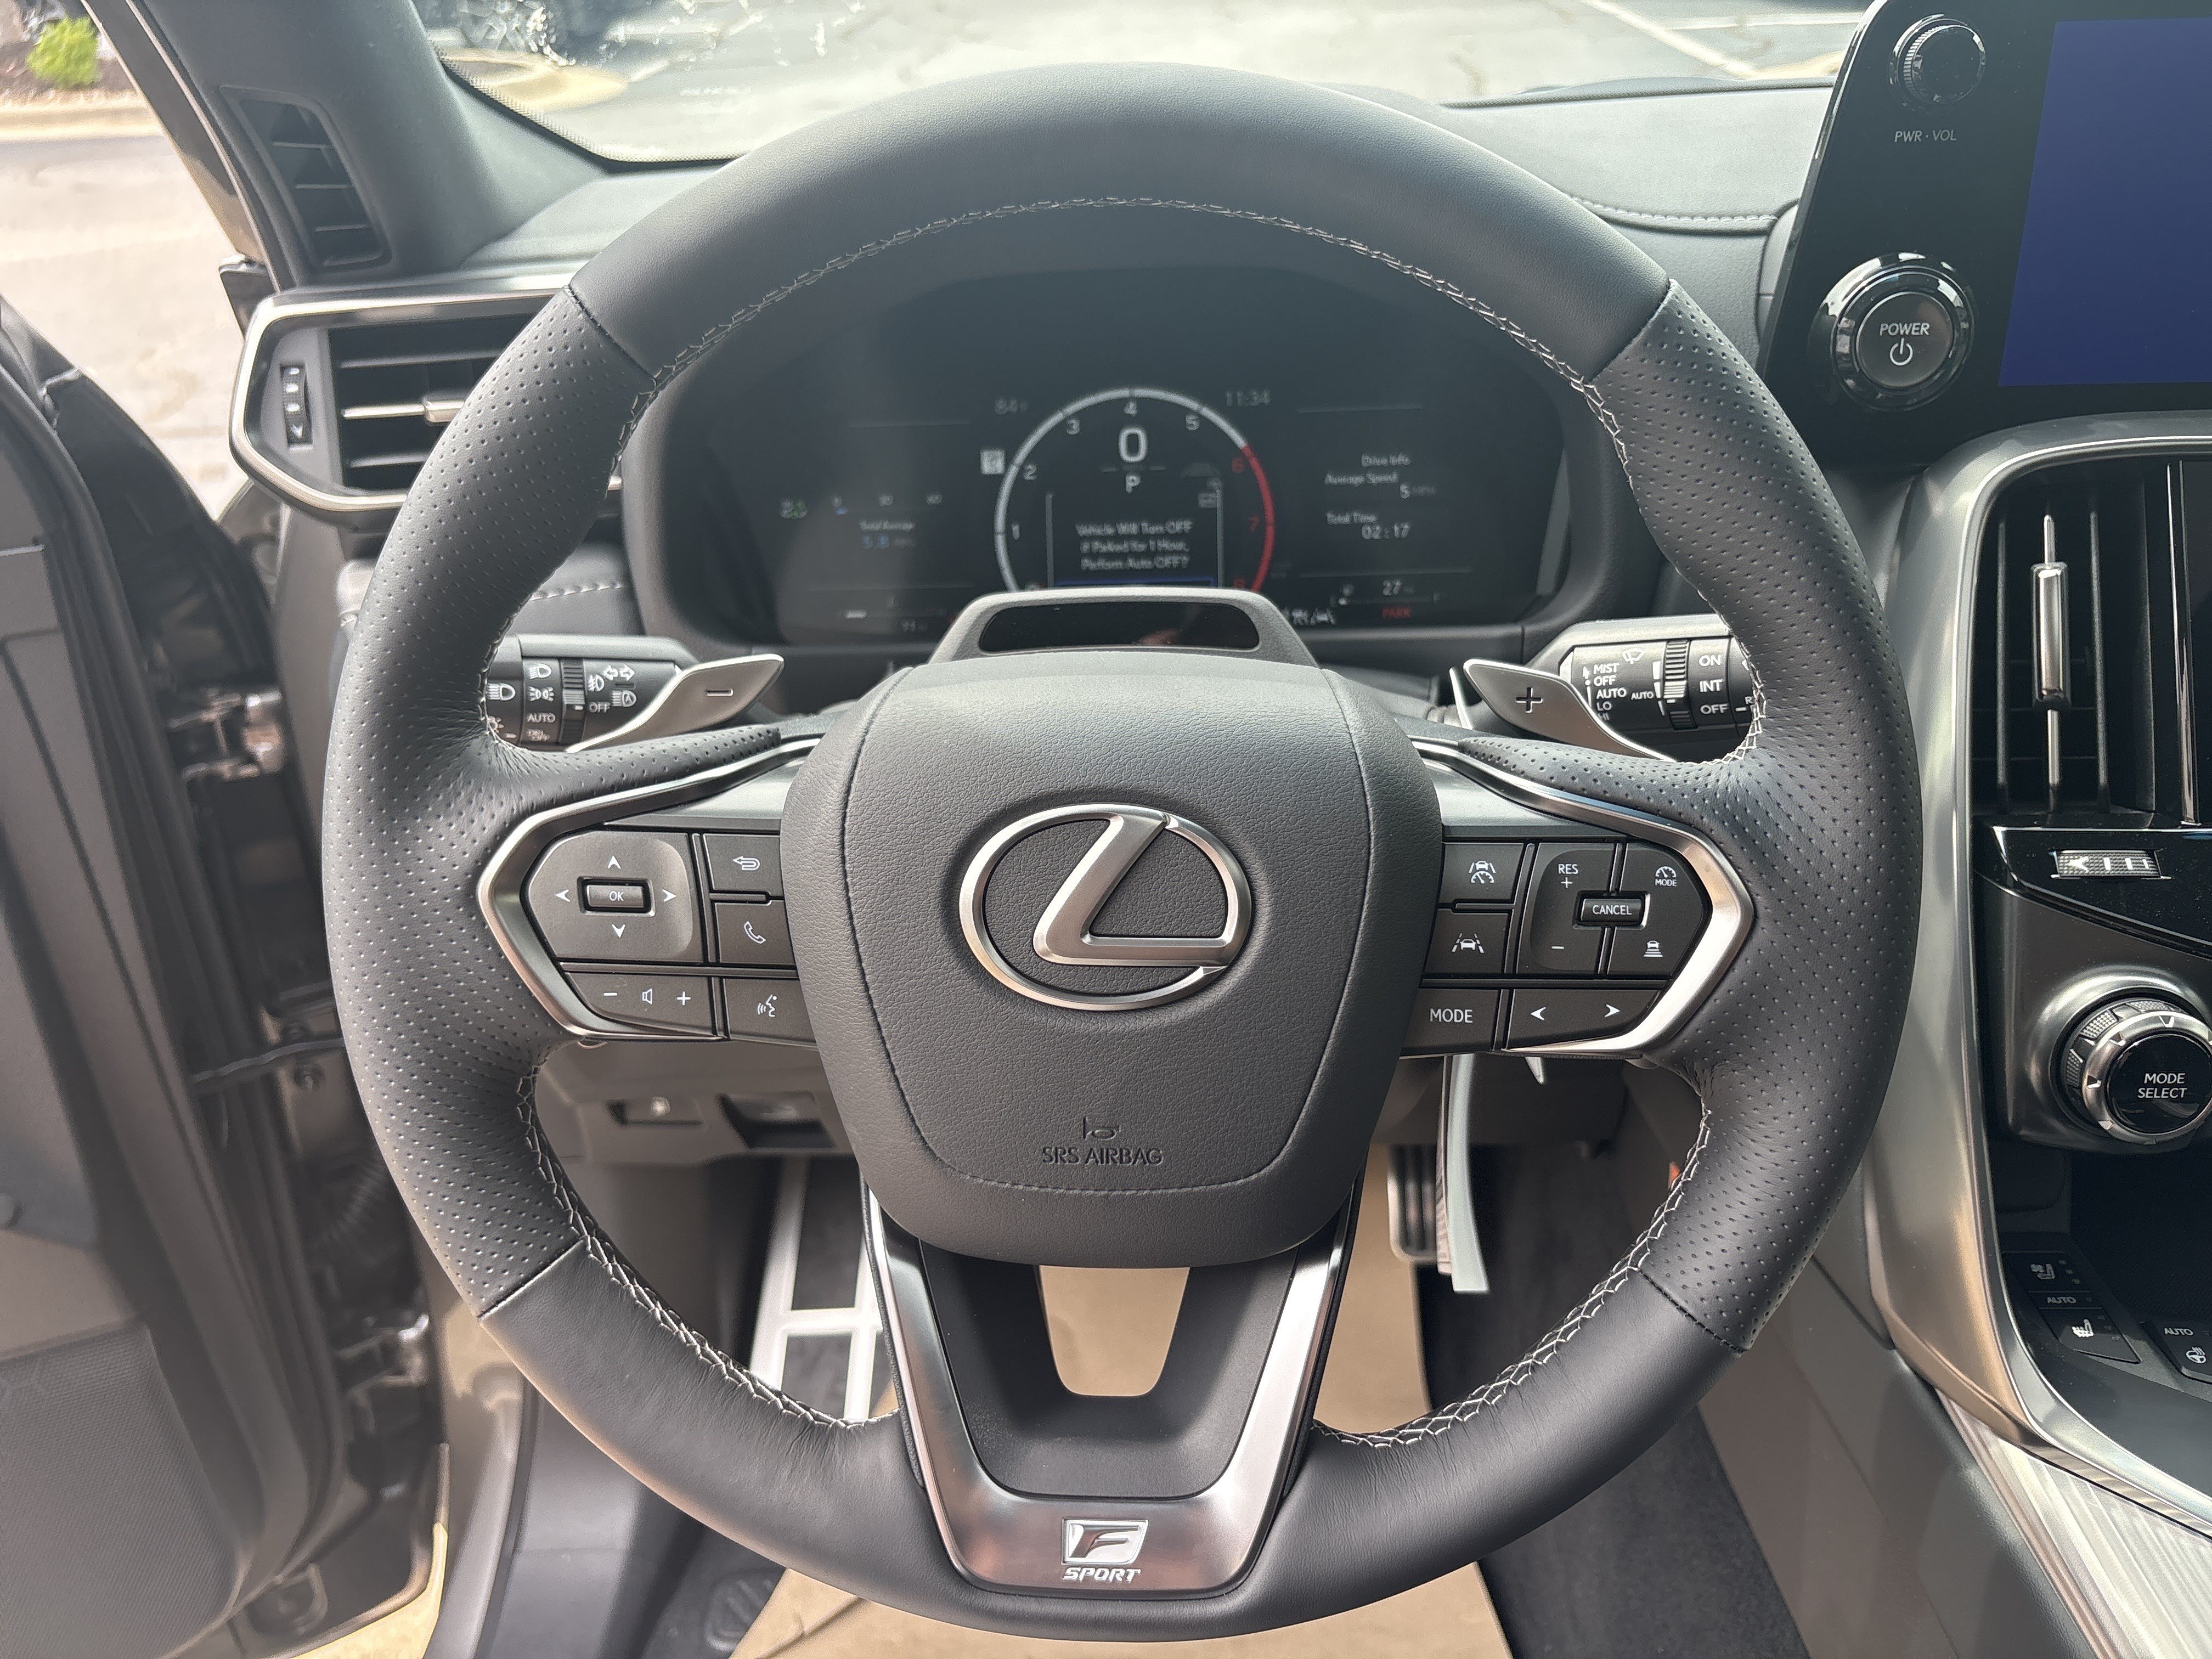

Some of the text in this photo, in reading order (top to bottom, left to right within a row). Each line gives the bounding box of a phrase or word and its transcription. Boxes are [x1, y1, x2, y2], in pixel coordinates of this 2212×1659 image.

[1894, 129, 1957, 142] PWR VOL
[1880, 323, 1930, 336] POWER
[1125, 401, 1138, 416] 4
[1066, 418, 1081, 435] 3
[1185, 413, 1200, 431] 5
[1118, 426, 1148, 462] 0
[1231, 457, 1245, 473] 6
[1023, 464, 1038, 481] 2
[1125, 473, 1142, 494] P
[1324, 471, 1399, 488] Average Speed
[1400, 482, 1411, 499] 5
[1249, 515, 1260, 532] 7
[1326, 511, 1378, 525] Total Time
[1012, 523, 1020, 540] 1
[1075, 519, 1193, 537] Vehicle Will Turn OFF
[1126, 554, 1153, 570] Auto
[1154, 554, 1190, 569] OFF?
[1383, 579, 1403, 596] 27
[1699, 654, 1722, 667] ON
[1593, 662, 1620, 675] MIST
[1593, 675, 1616, 686] OFF
[1699, 679, 1723, 692] INT
[1596, 687, 1627, 699] AUTO
[1630, 691, 1655, 700] AUTO
[589, 702, 611, 713] OFF
[1596, 701, 1612, 711] LO
[1700, 703, 1729, 714] OFF
[527, 713, 556, 724] AUTO
[1558, 864, 1579, 875] RES
[1655, 878, 1678, 887] MODE
[608, 890, 624, 902] OK
[1592, 905, 1633, 916] CANCEL
[1430, 1008, 1473, 1023] MODE
[2144, 1073, 2186, 1084] MODE
[2137, 1087, 2188, 1098] SELECT
[1042, 1146, 1164, 1166] SRS AIRBAG
[2047, 1296, 2077, 1304] AUTO
[2164, 1327, 2194, 1336] AUTO
[1062, 1567, 1142, 1584] SPORT
